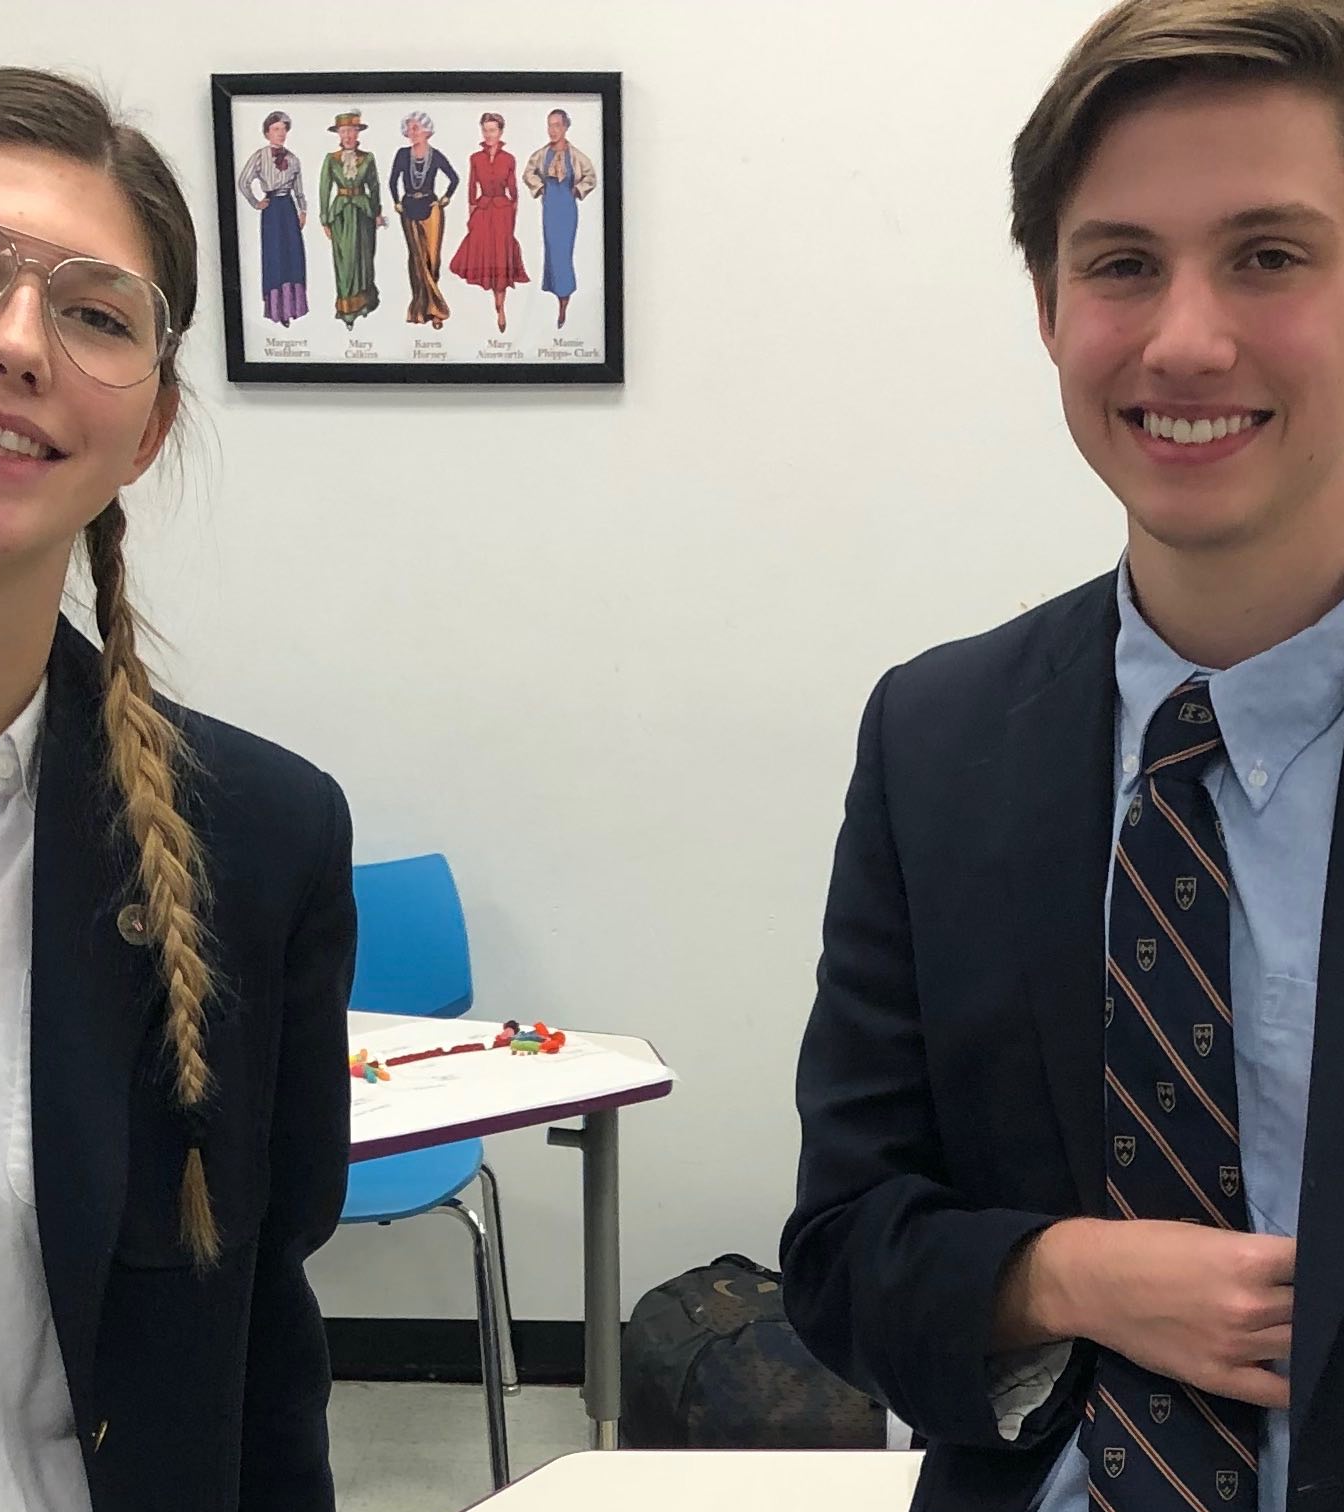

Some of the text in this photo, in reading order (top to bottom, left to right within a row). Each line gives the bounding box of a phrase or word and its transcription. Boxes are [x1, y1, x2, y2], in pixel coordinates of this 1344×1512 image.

[349, 339, 373, 351] Mary
[415, 340, 442, 348] Karen
[487, 340, 513, 350] Mary
